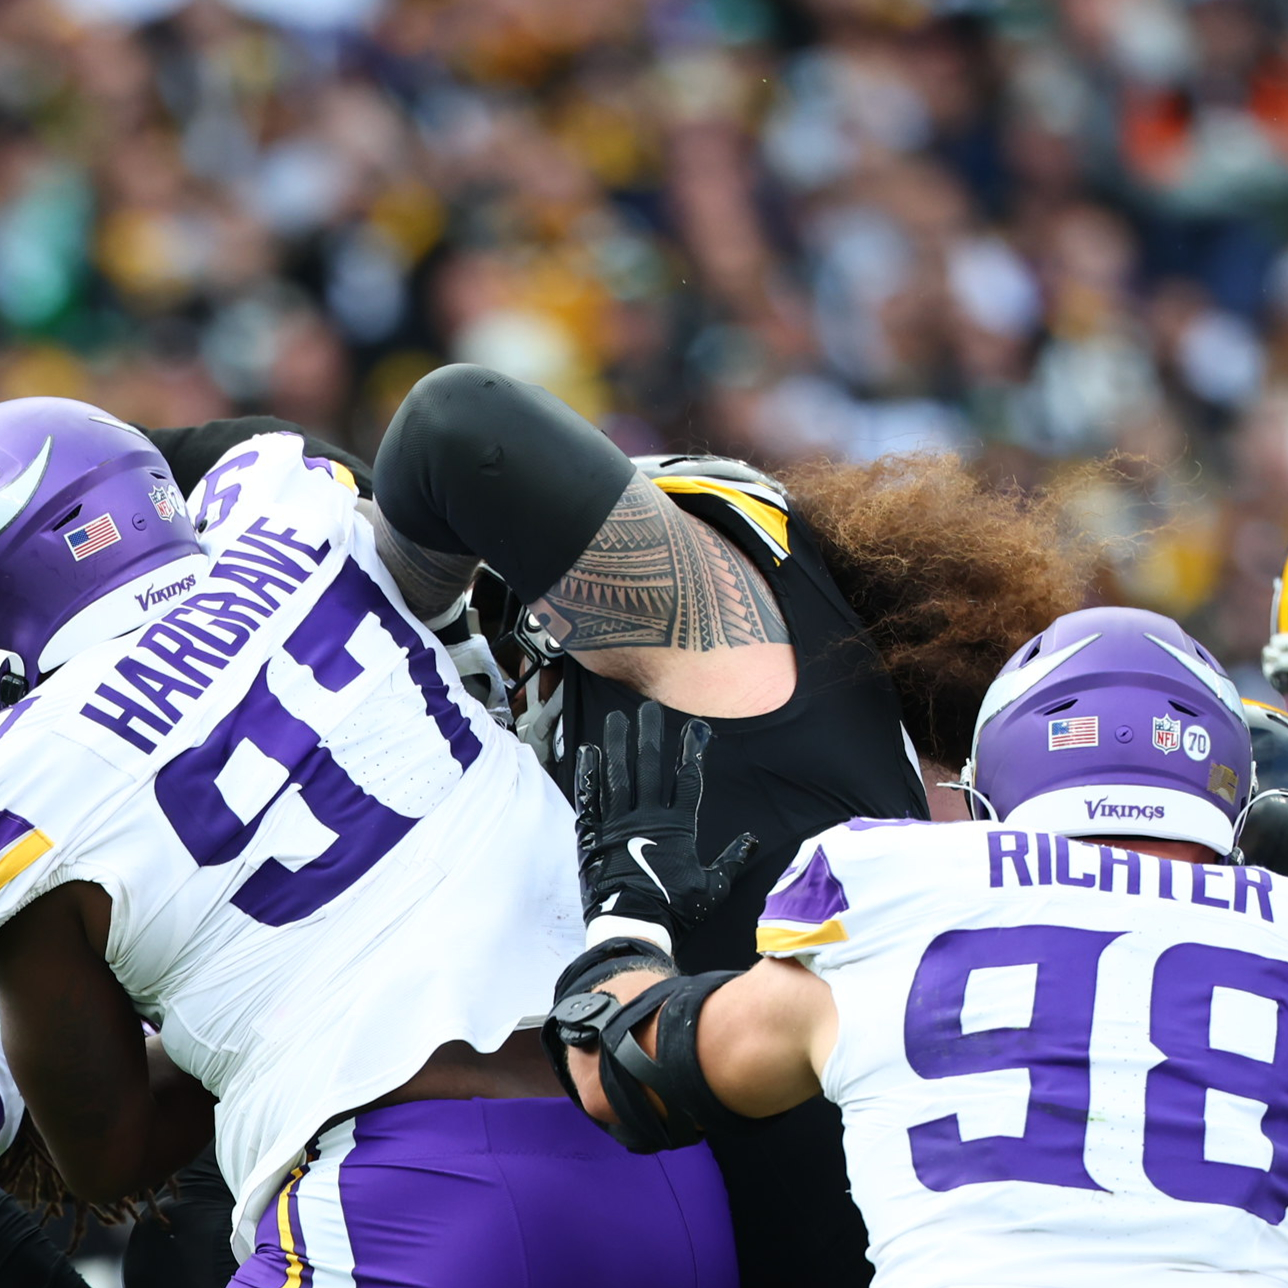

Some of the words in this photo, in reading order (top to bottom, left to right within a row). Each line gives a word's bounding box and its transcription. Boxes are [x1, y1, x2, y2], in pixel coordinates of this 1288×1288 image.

[80, 516, 332, 754] HARGRAVE
[153, 553, 483, 927] 97
[1156, 731, 1176, 747] NFL
[1188, 732, 1207, 754] 70
[987, 831, 1274, 923] RICHTER
